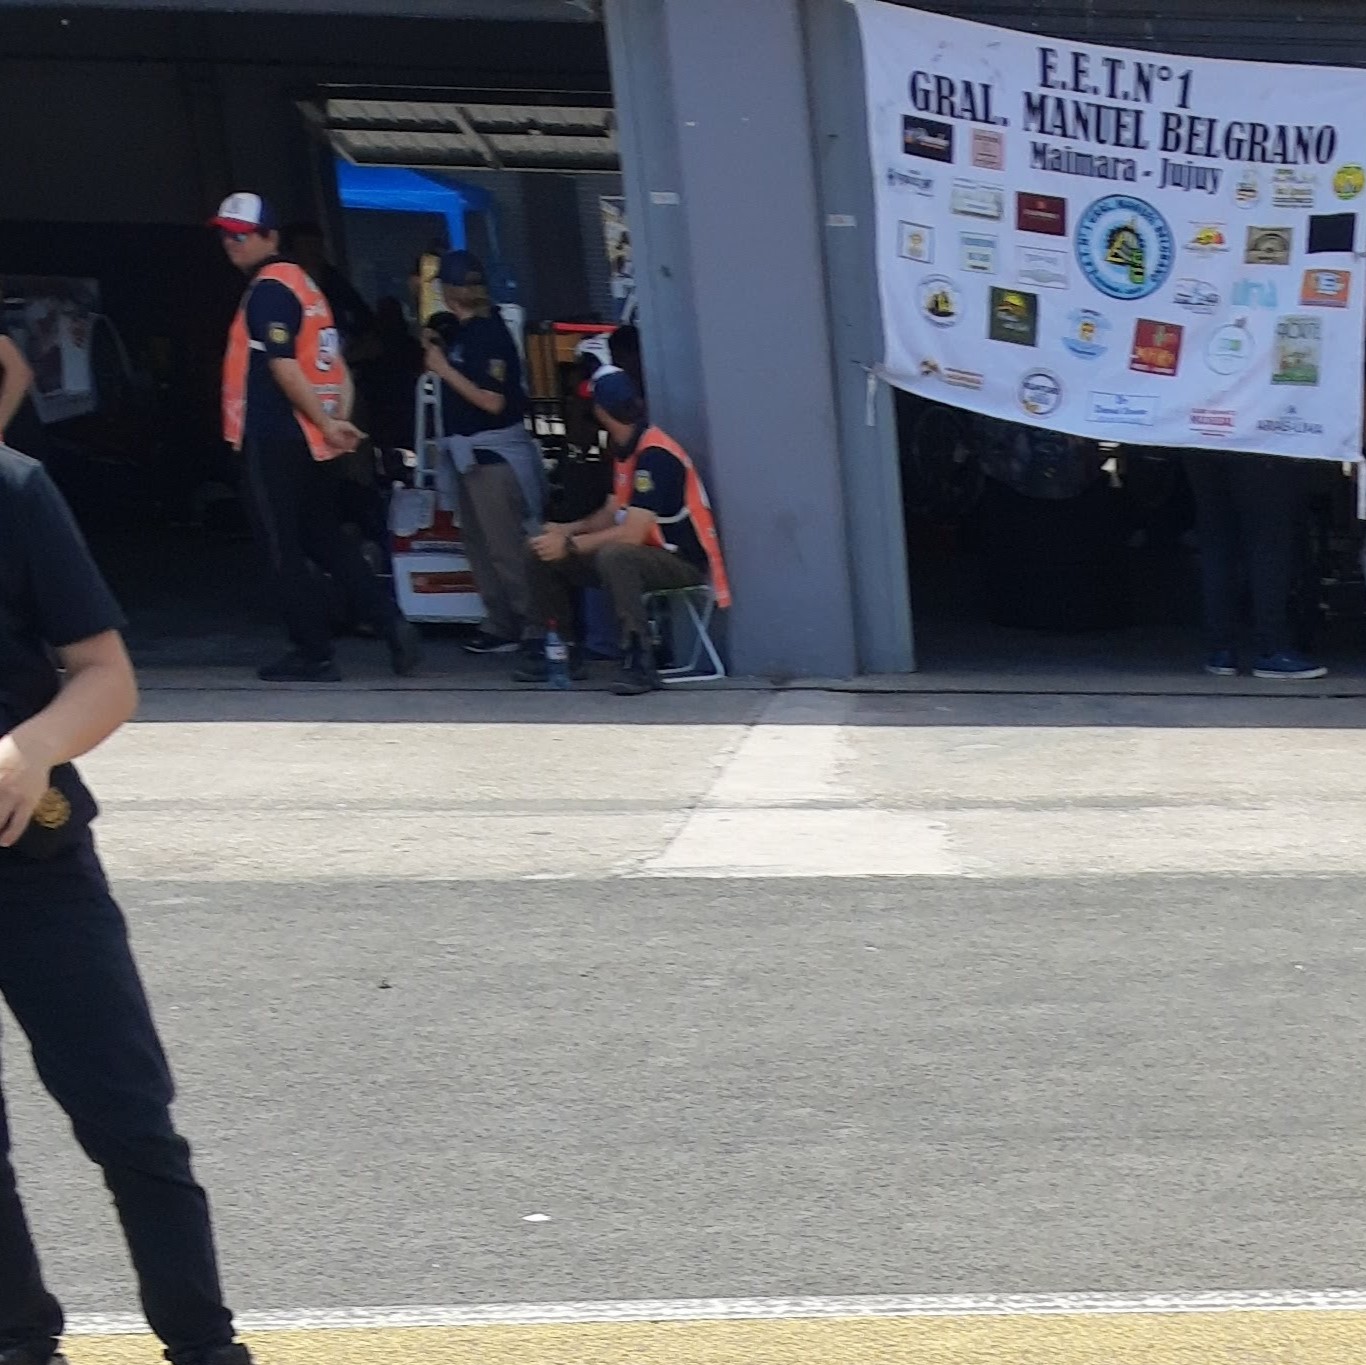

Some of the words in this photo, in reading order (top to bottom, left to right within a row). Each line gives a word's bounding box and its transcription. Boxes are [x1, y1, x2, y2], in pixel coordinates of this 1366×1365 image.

[908, 70, 1009, 127] GRAL.
[1022, 91, 1149, 151] MANUEL
[1159, 111, 1338, 165] BELGRANO
[1029, 141, 1137, 183] Maimara
[1157, 157, 1223, 195] Jujuy
